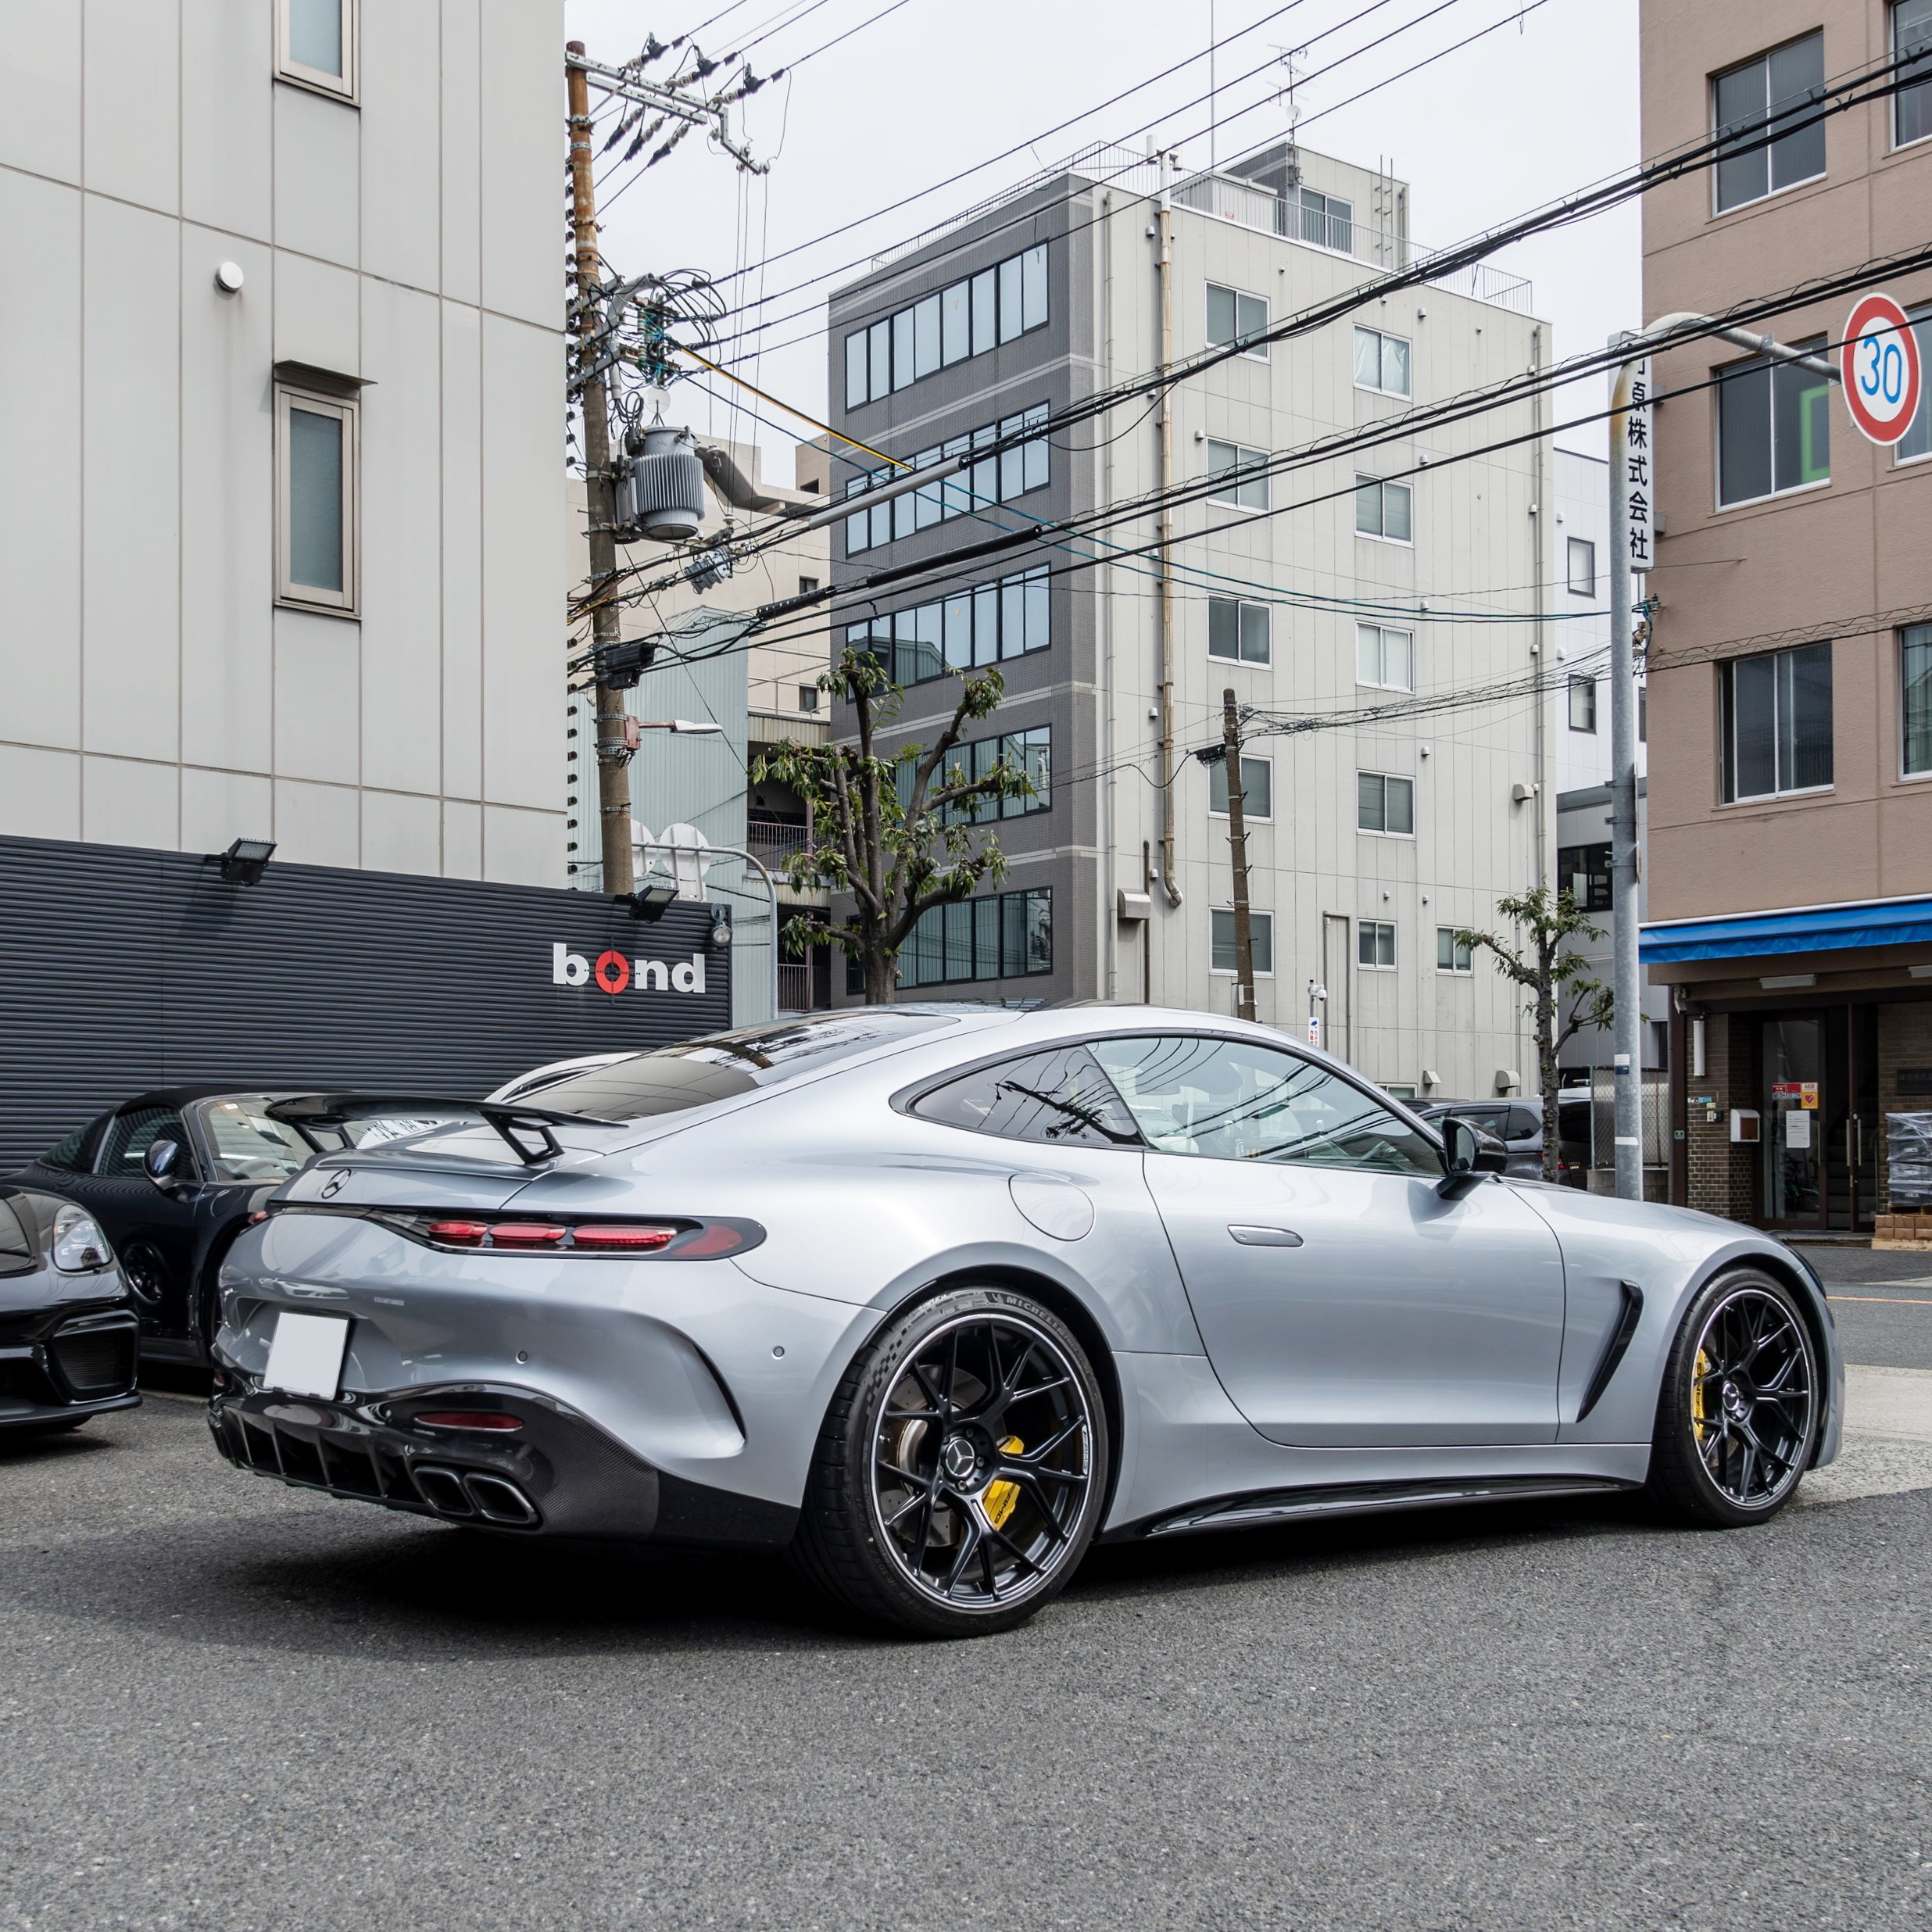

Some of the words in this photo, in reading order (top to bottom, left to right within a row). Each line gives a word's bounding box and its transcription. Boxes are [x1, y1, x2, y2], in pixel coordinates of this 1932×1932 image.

[1861, 336, 1902, 403] 30
[1628, 345, 1648, 560] 原株式会社
[553, 943, 706, 994] bond
[1007, 1296, 1064, 1335] MICHELIN
[994, 1490, 1012, 1524] AMG
